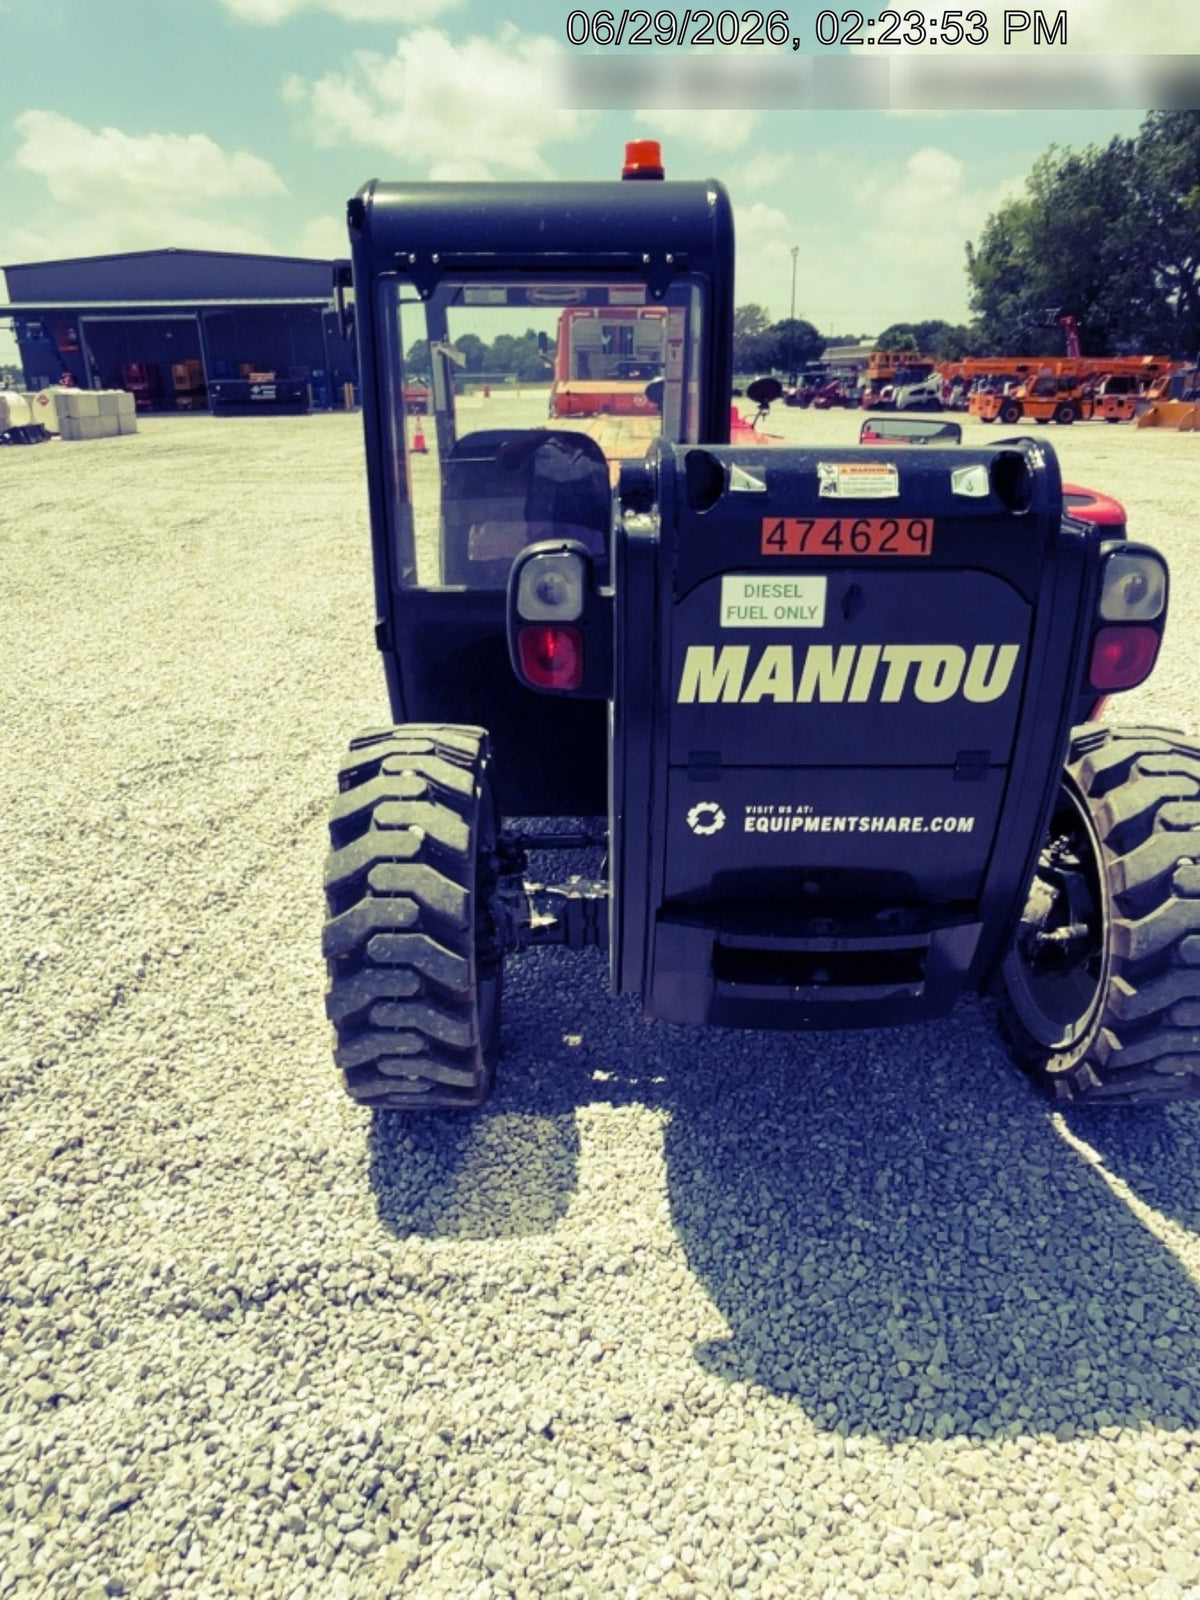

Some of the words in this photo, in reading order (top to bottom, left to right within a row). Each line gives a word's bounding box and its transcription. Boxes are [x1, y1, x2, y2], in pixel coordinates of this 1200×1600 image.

[765, 519, 930, 553] 474629
[744, 584, 803, 599] DIESEL
[726, 605, 769, 620] FUEL
[773, 605, 819, 620] ONLY
[677, 644, 1021, 704] MANITOU
[745, 805, 774, 814] VISIT
[778, 805, 793, 814] US
[744, 816, 974, 833] EQUIPMENTSHARE.COM
